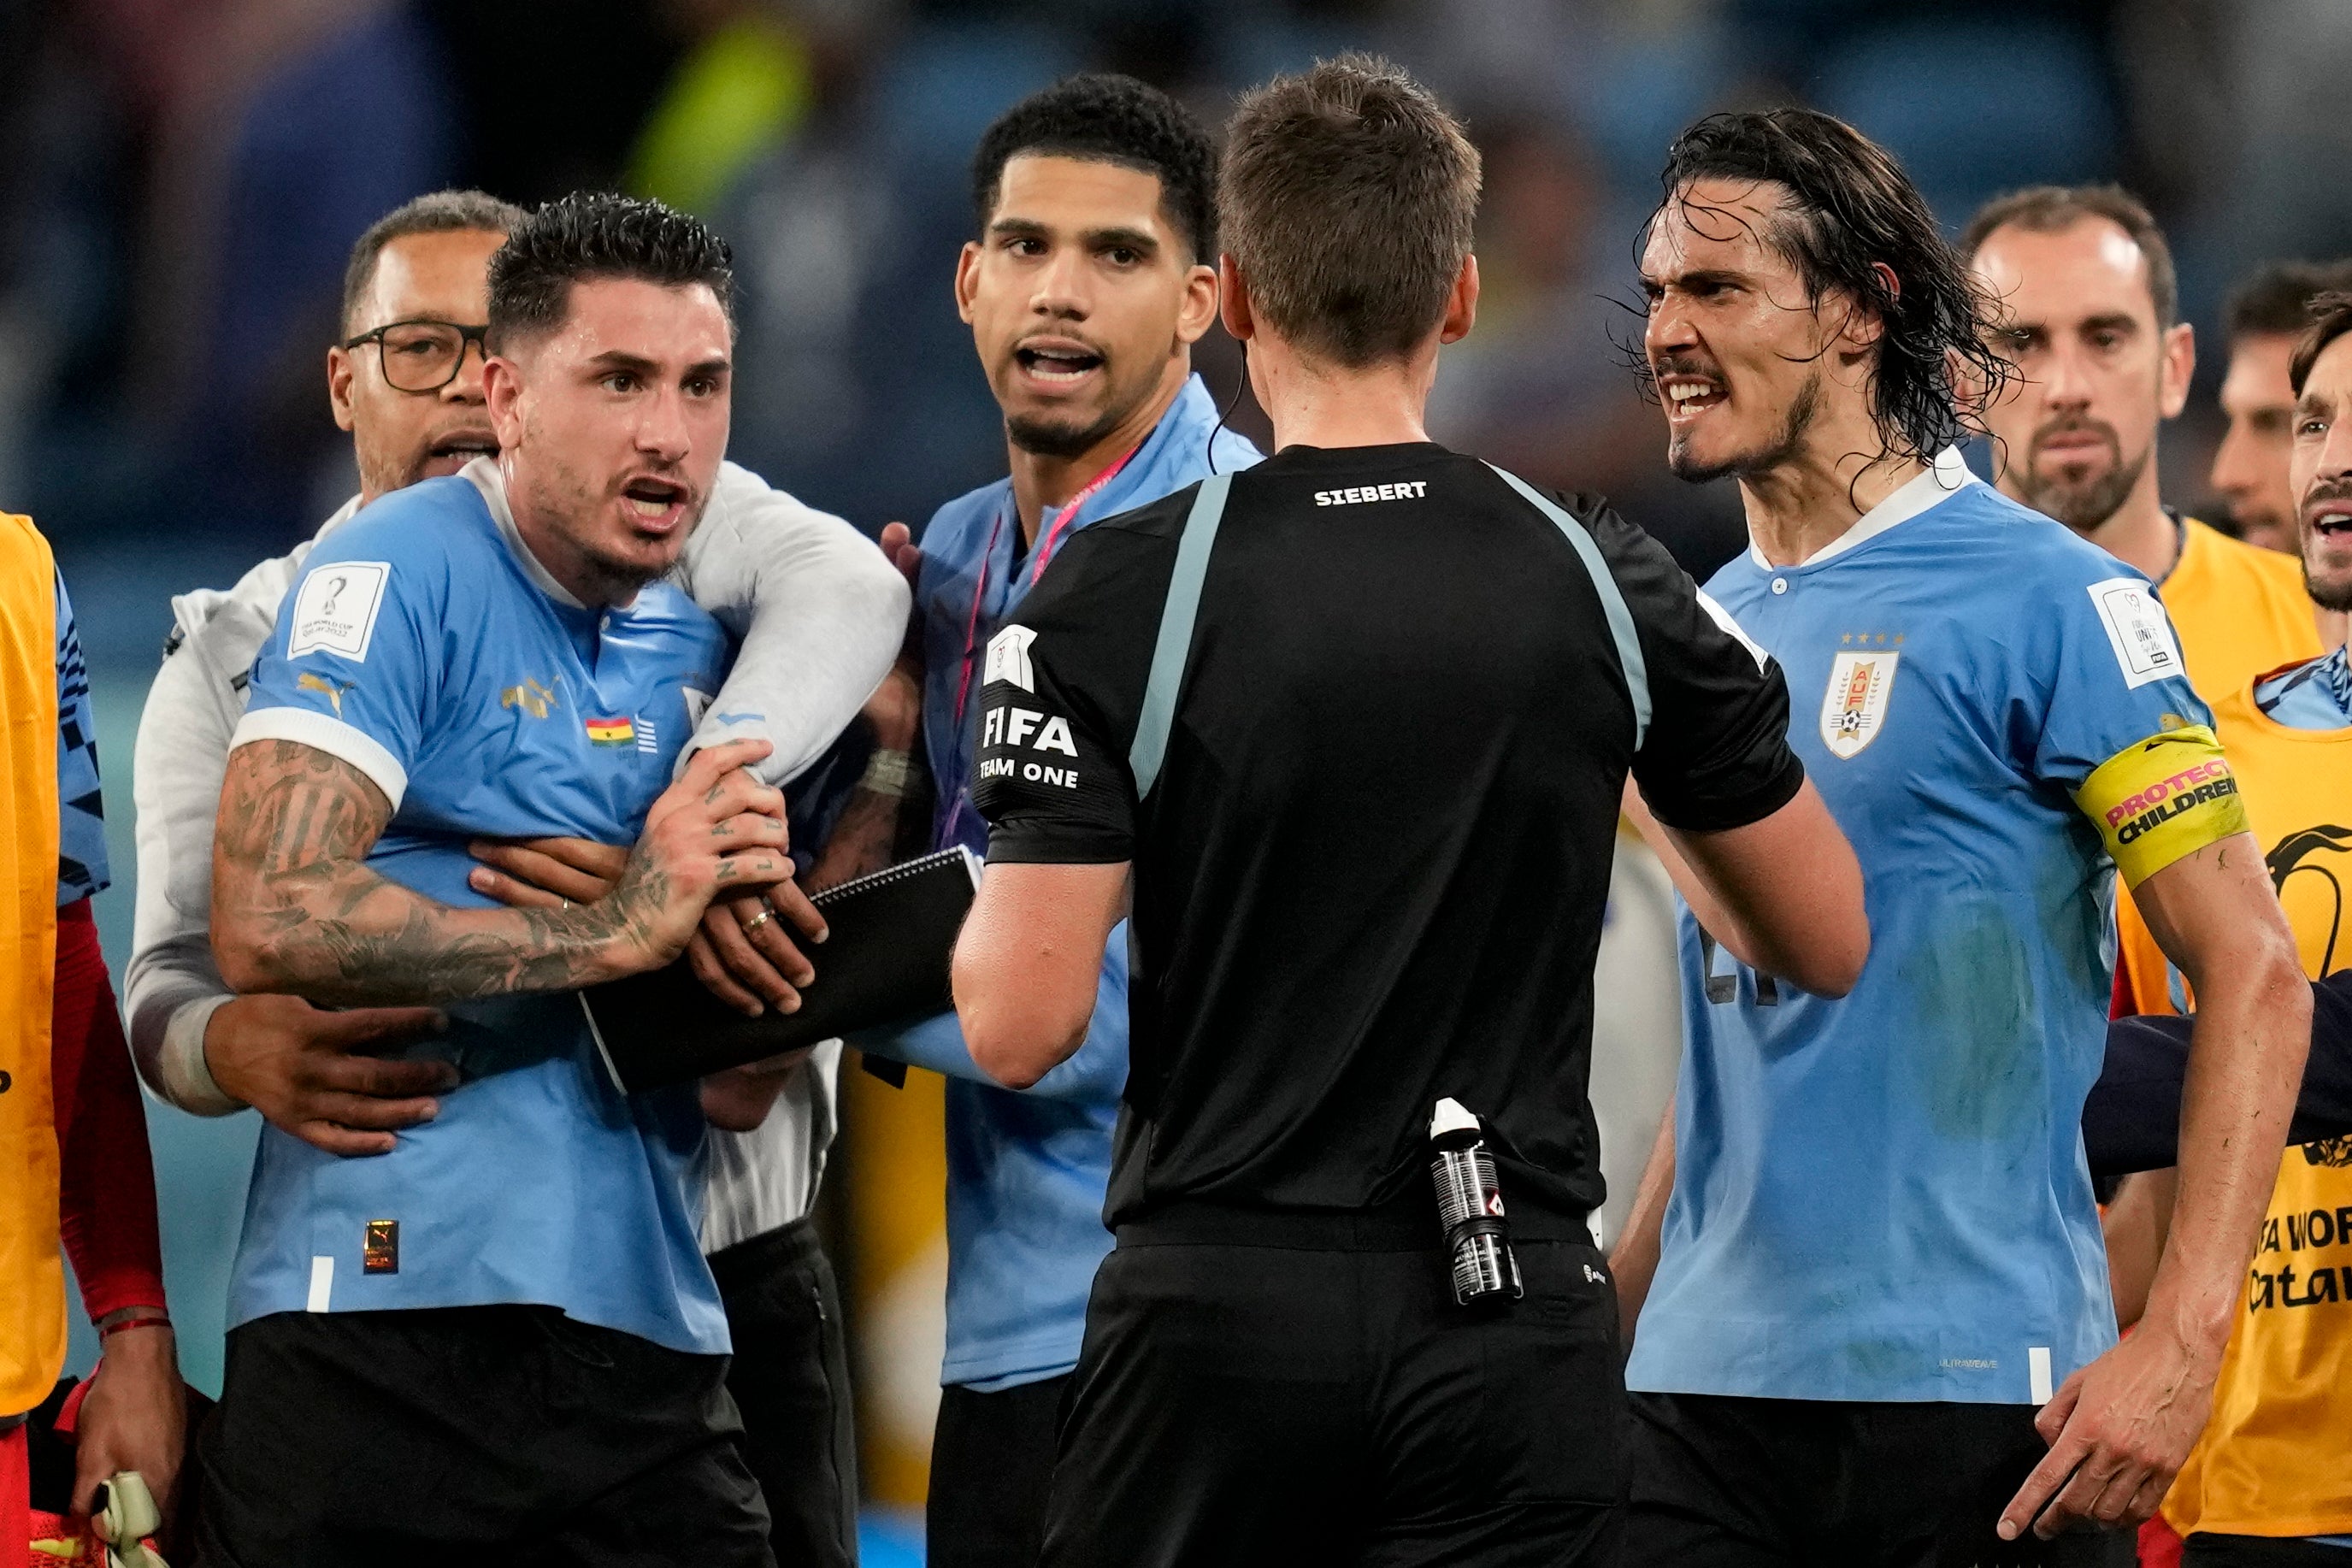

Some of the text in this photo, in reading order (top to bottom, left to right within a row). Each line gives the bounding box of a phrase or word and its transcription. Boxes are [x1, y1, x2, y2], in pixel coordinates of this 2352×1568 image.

[1314, 480, 1427, 507] SIEBERT
[1848, 670, 1868, 707] AUF
[983, 706, 1079, 757] FIFA
[981, 757, 1079, 789] TEAM ONE
[2118, 777, 2238, 845] CHILDREN
